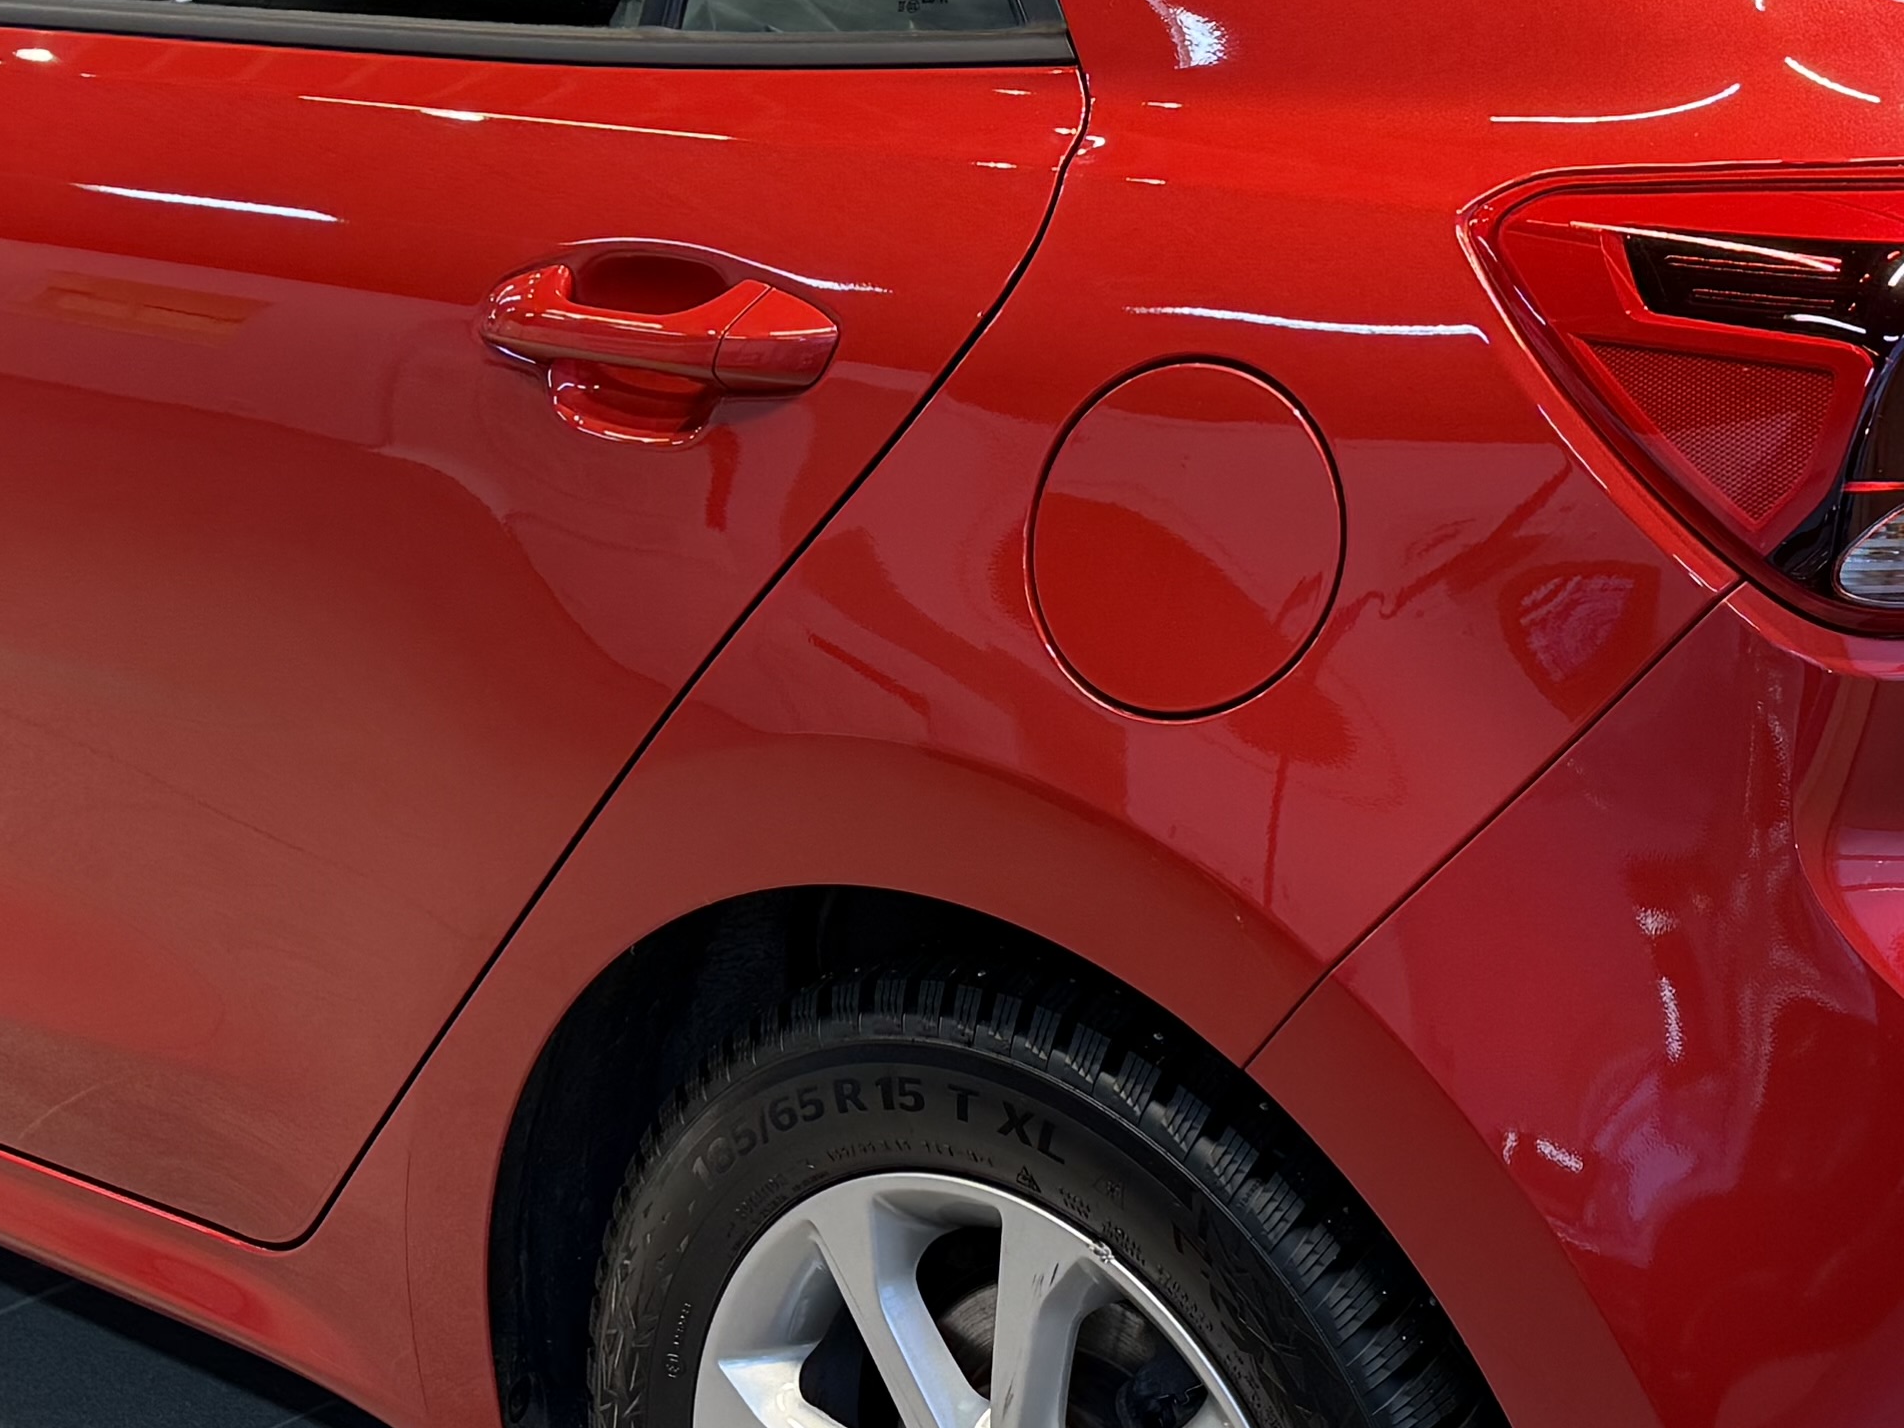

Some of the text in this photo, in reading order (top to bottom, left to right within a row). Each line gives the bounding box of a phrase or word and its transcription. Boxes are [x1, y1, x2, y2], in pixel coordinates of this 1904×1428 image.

[880, 1076, 926, 1113] 15
[948, 1084, 980, 1122] T
[997, 1101, 1066, 1165] XL
